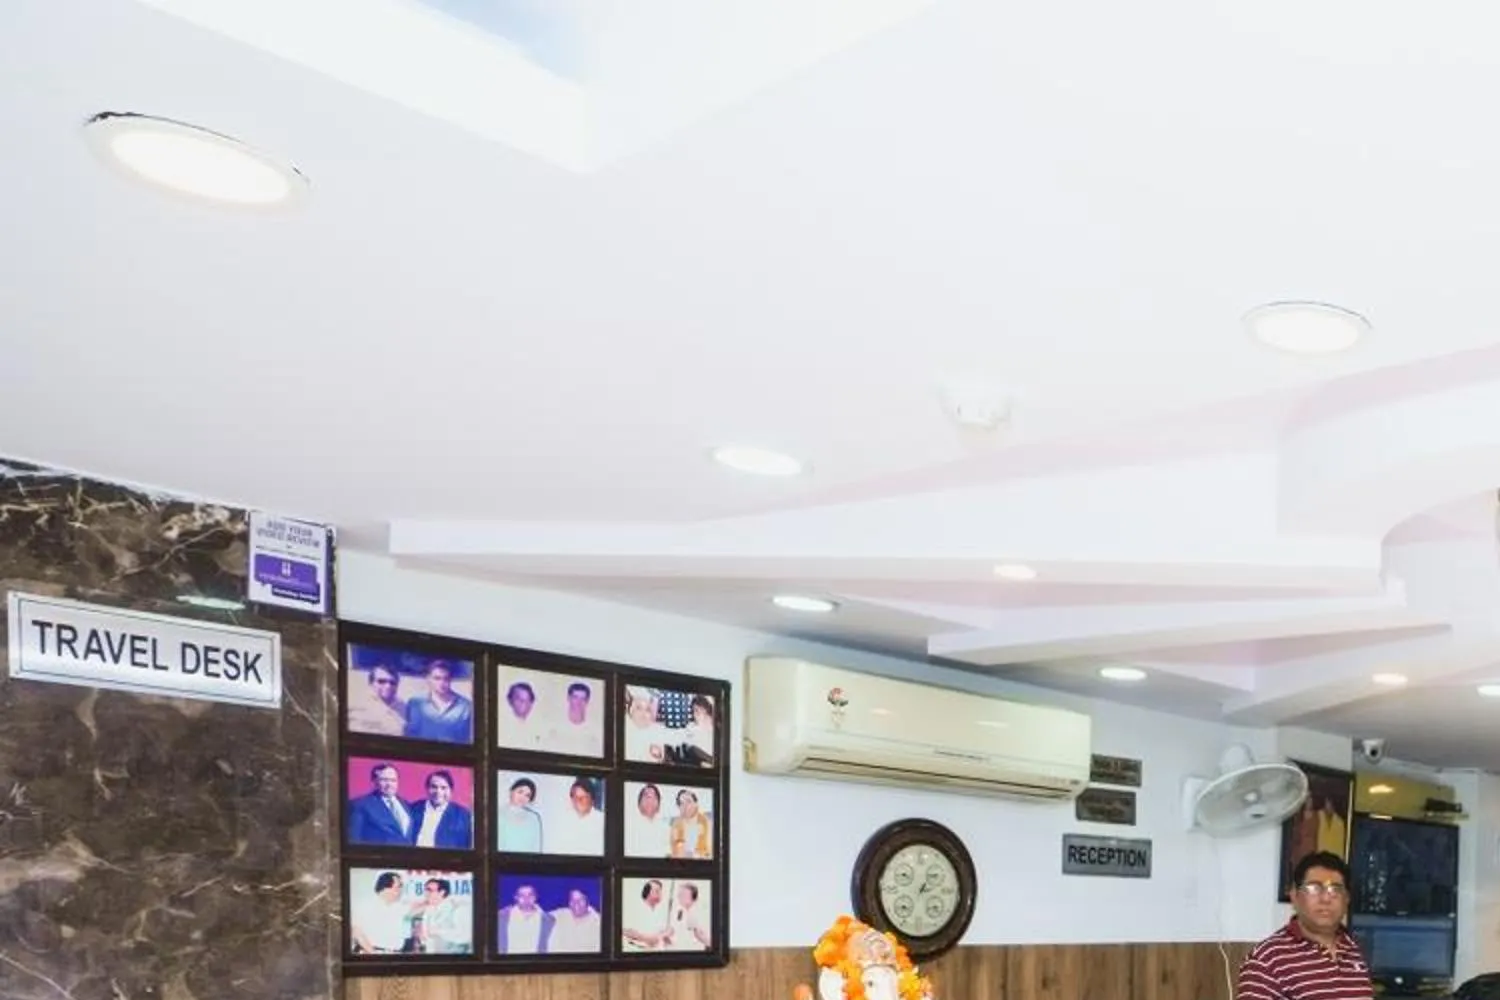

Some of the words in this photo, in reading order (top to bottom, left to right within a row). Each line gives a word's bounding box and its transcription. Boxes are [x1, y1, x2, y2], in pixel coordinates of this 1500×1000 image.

[31, 619, 169, 671] TRAVEL
[181, 641, 263, 685] DESK
[1068, 845, 1147, 867] RECEPTION
